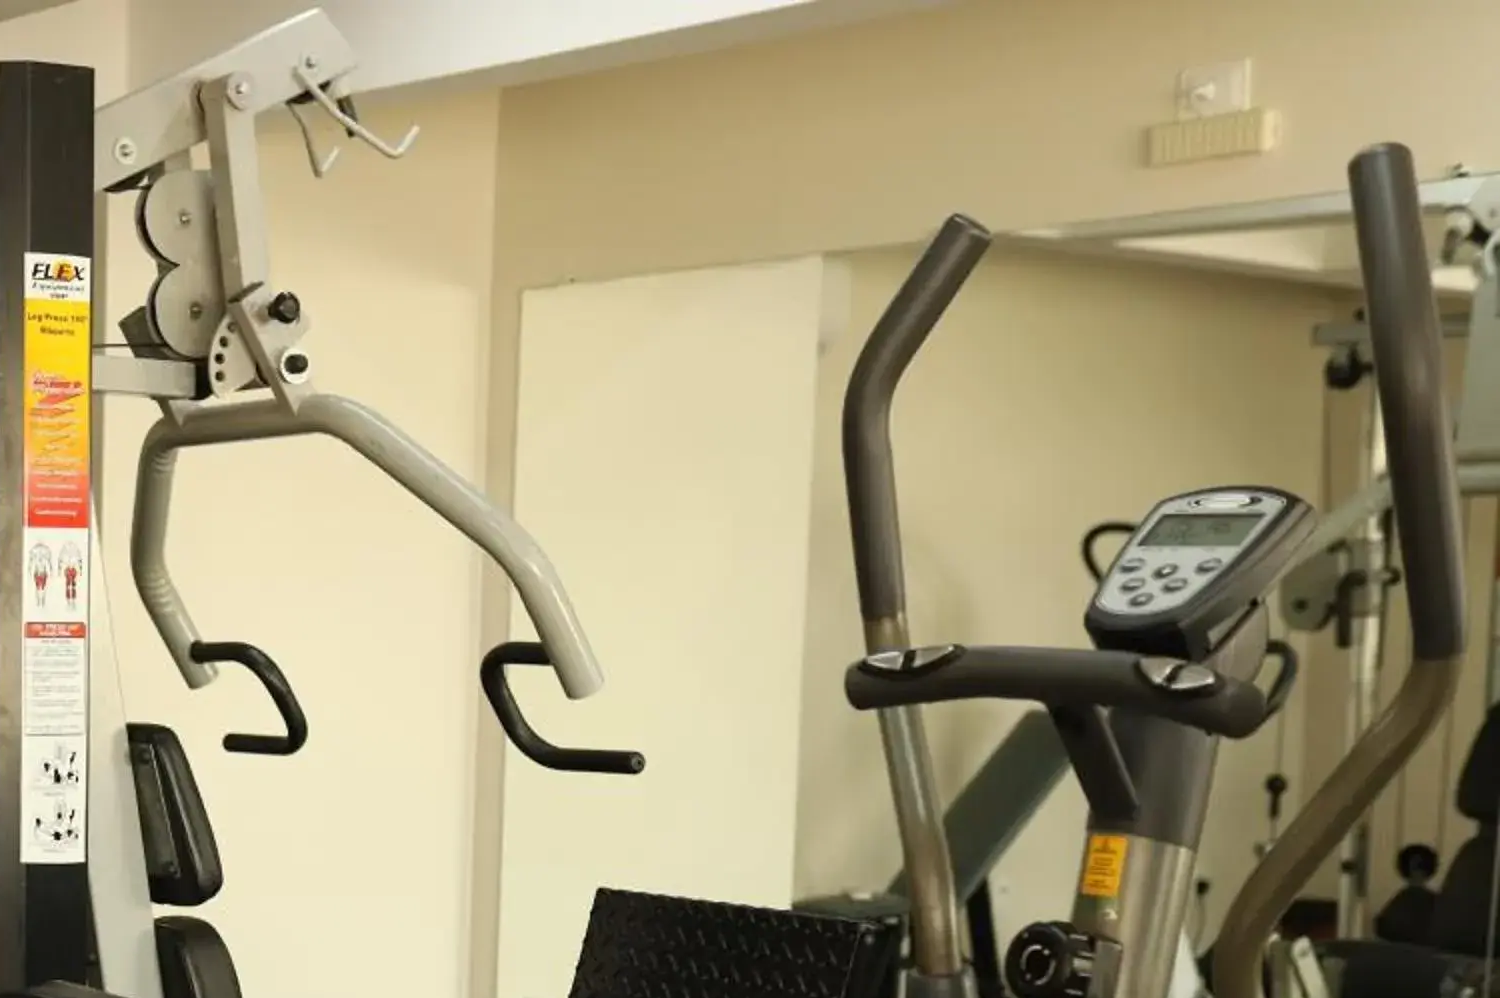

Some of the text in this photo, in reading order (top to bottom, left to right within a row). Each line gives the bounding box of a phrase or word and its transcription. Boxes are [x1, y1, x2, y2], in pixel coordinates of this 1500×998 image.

[32, 263, 85, 281] FLEX
[28, 312, 43, 323] Leg
[44, 313, 68, 323] Press
